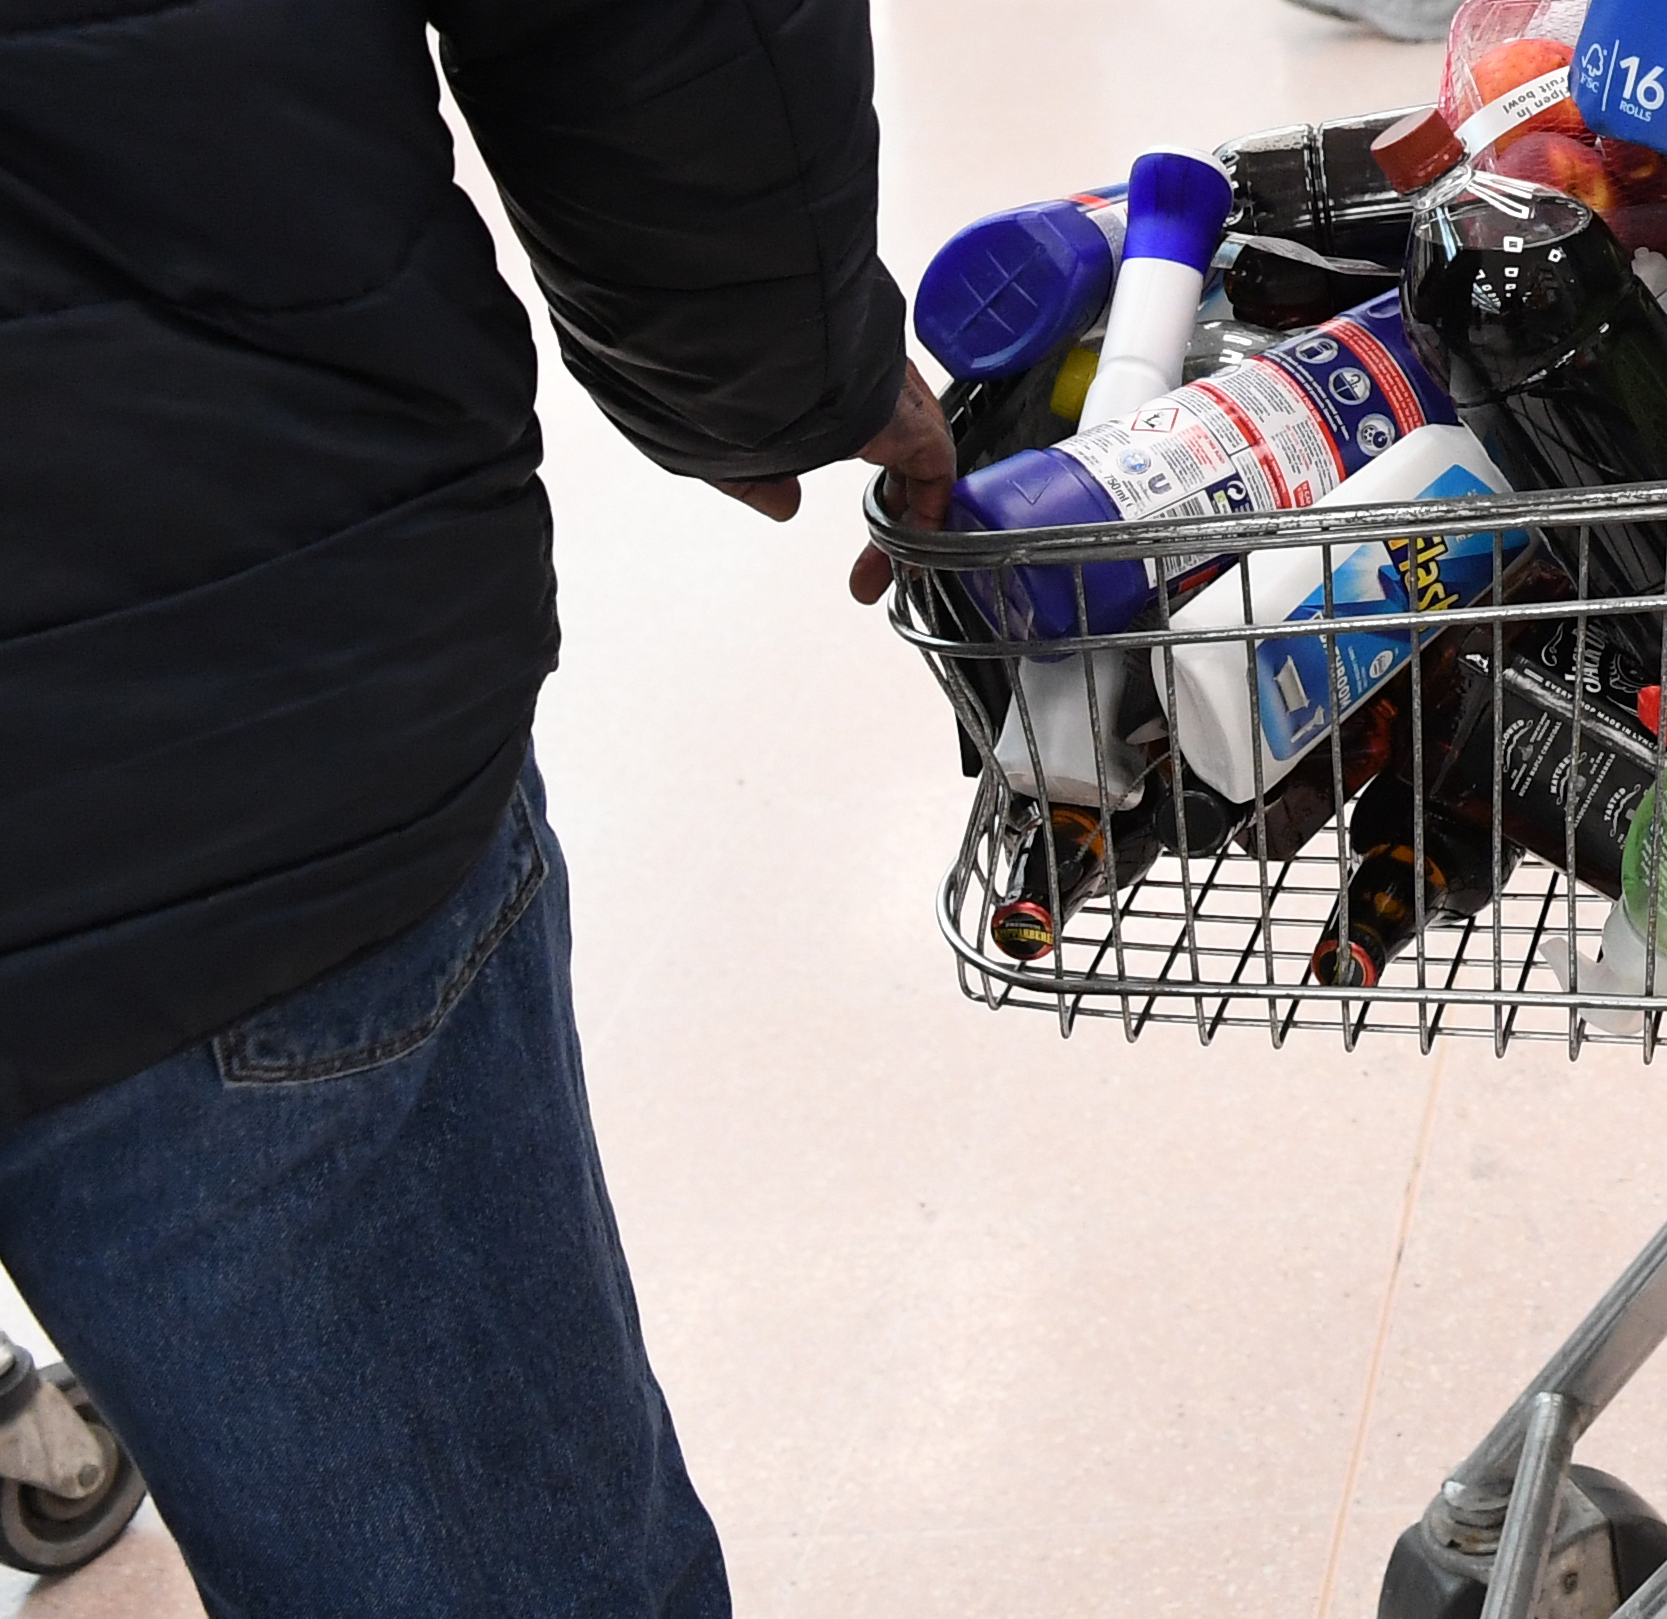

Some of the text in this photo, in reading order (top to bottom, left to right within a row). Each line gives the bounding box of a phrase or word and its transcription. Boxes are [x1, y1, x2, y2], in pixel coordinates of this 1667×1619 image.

[1502, 76, 1566, 115] ruit bowl
[1579, 71, 1600, 95] FSC
[1618, 55, 1666, 111] 16
[1516, 107, 1533, 119] in
[1618, 99, 1652, 123] ROLLS
[1104, 472, 1130, 504] 750ml
[1596, 710, 1622, 729] MADE
[1603, 786, 1627, 822] TASTED
